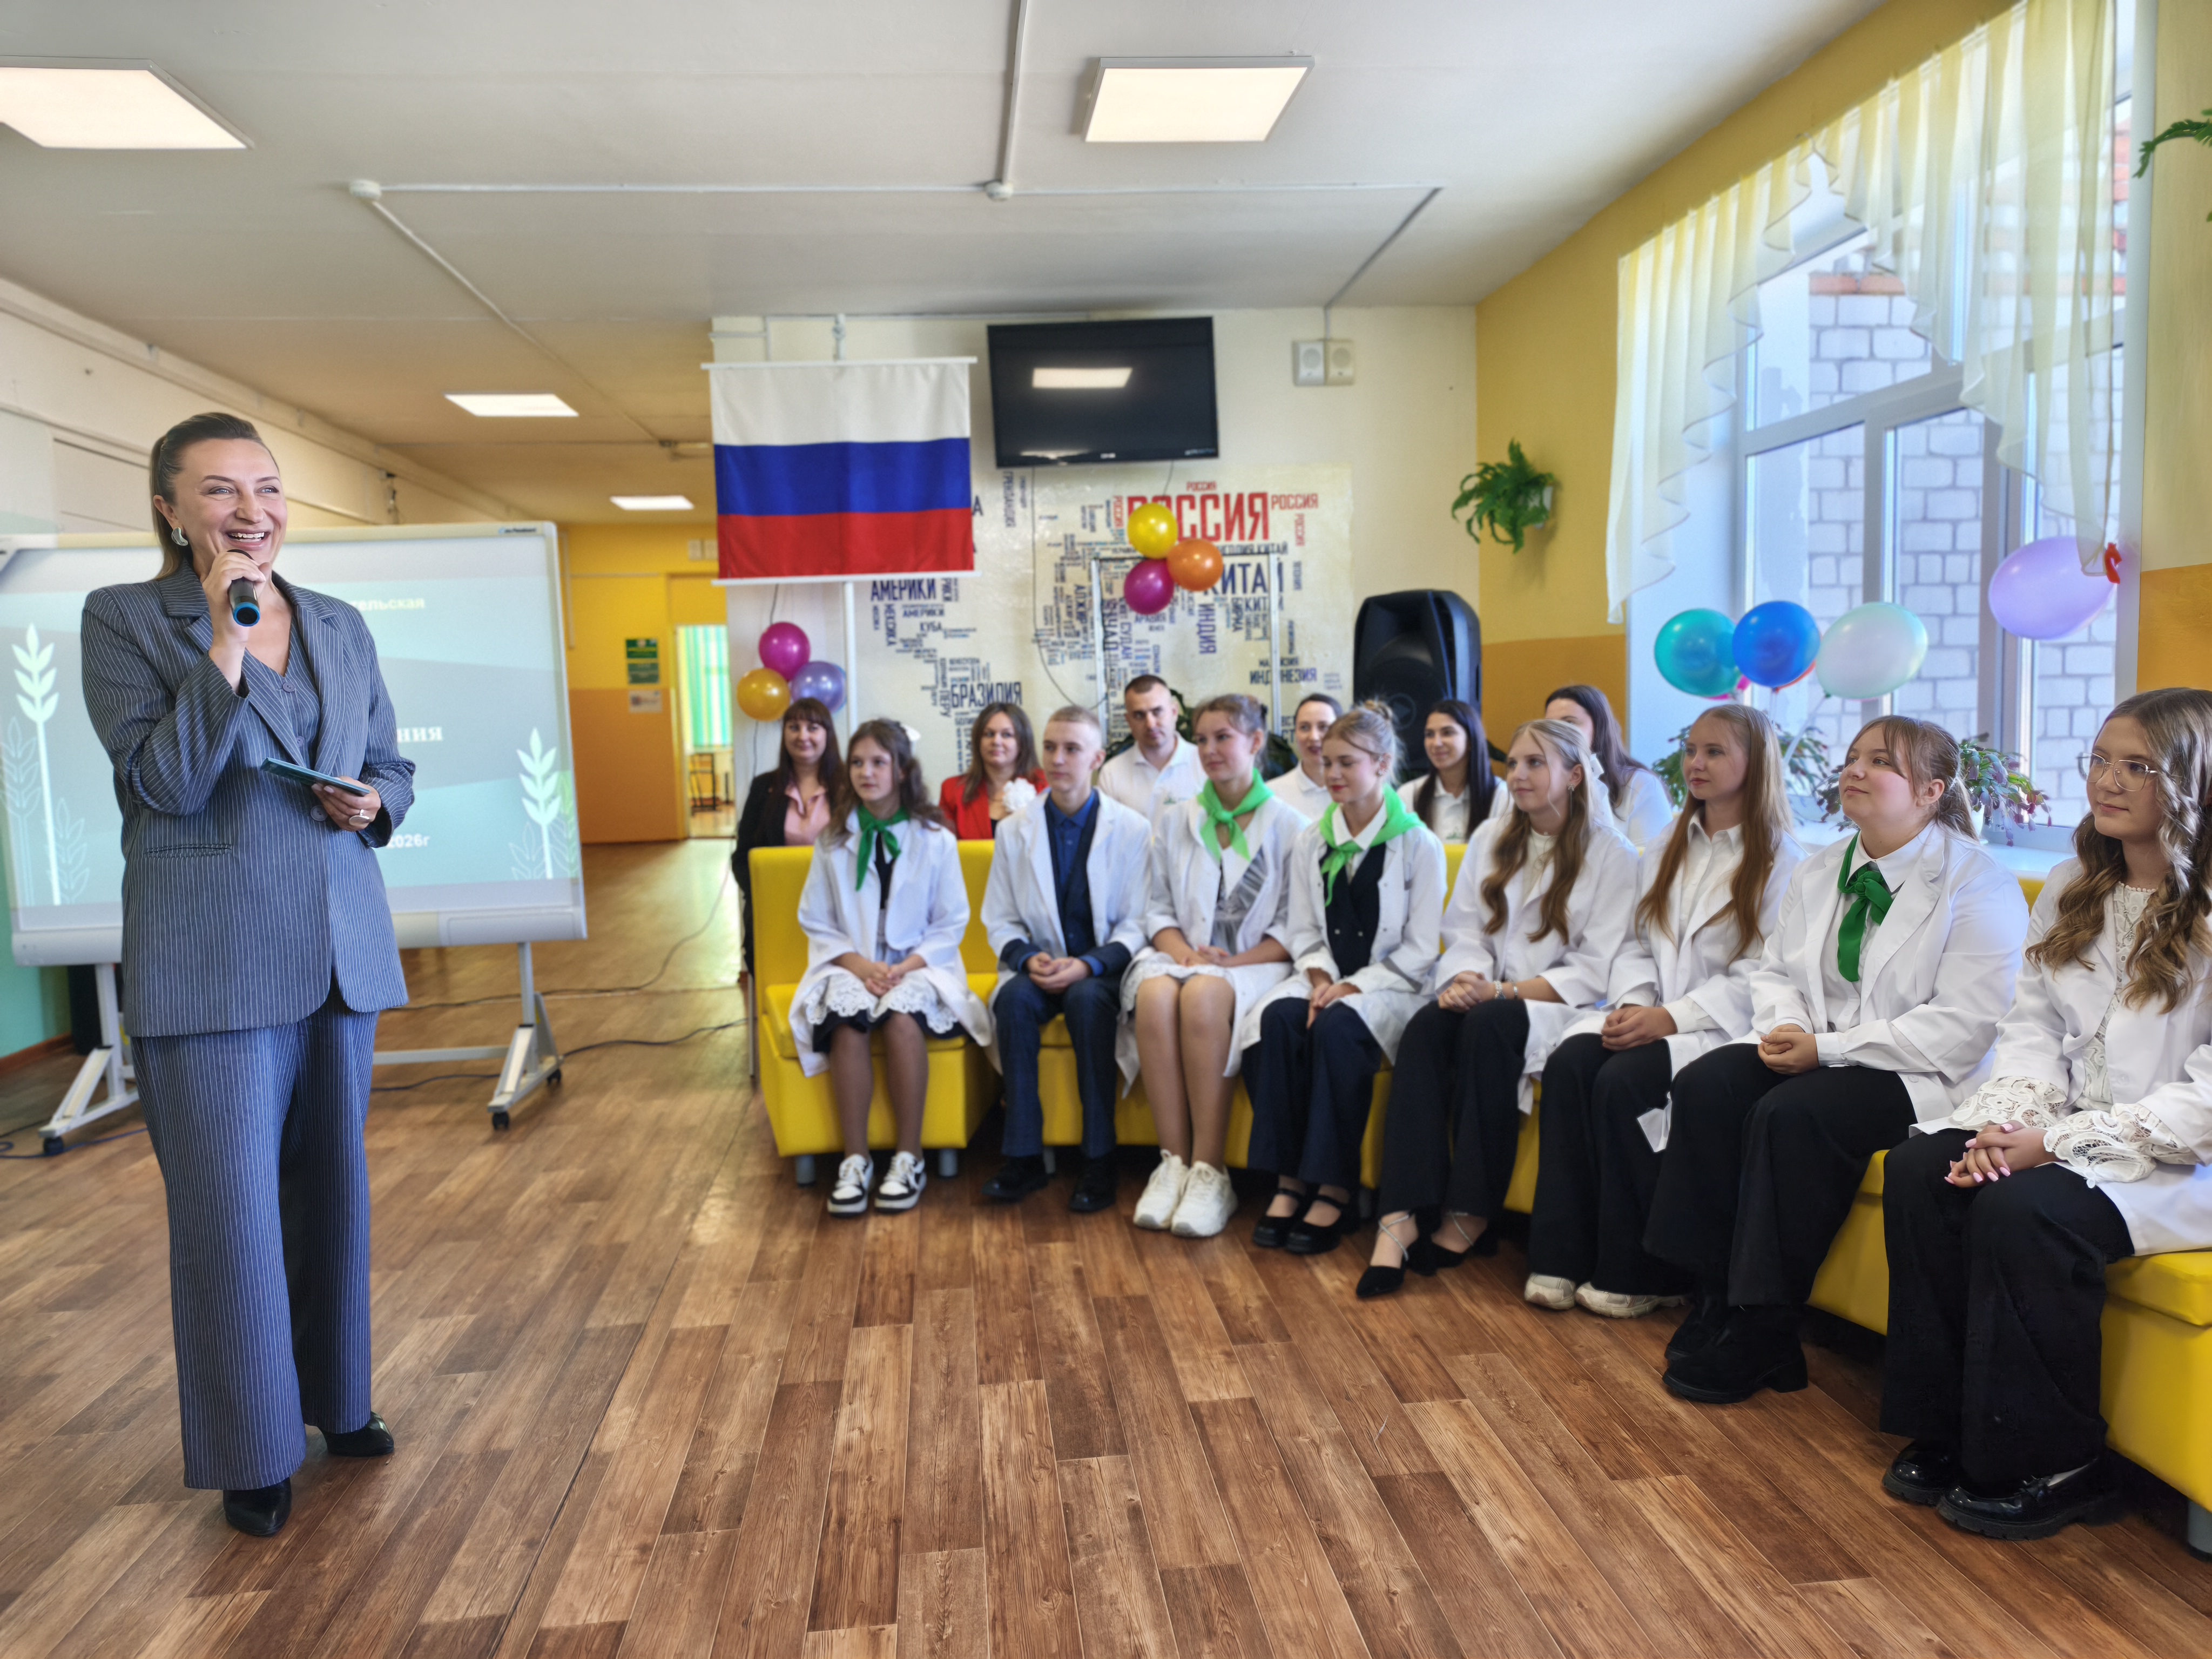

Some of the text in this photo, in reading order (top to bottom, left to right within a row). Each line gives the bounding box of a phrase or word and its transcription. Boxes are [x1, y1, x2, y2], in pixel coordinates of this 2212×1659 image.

[1186, 481, 1217, 491] РОССИЯ
[1114, 495, 1124, 528] РОССИЯ
[1271, 493, 1318, 510] РОССИЯ
[1294, 514, 1305, 546] РОССИЯ
[871, 579, 936, 602] АМЕРИКИ
[1074, 584, 1088, 624] АЛЖИР
[885, 604, 896, 646] МЕКСИКА
[920, 622, 942, 632] КУБА
[1197, 603, 1217, 655] ИНДИЯ
[1120, 622, 1132, 659] СУДАН
[1250, 667, 1317, 685] ИНДНЕЗИЯ
[940, 690, 952, 718] ПЕРУ
[950, 682, 1023, 709] БРАЗИЛИЯ
